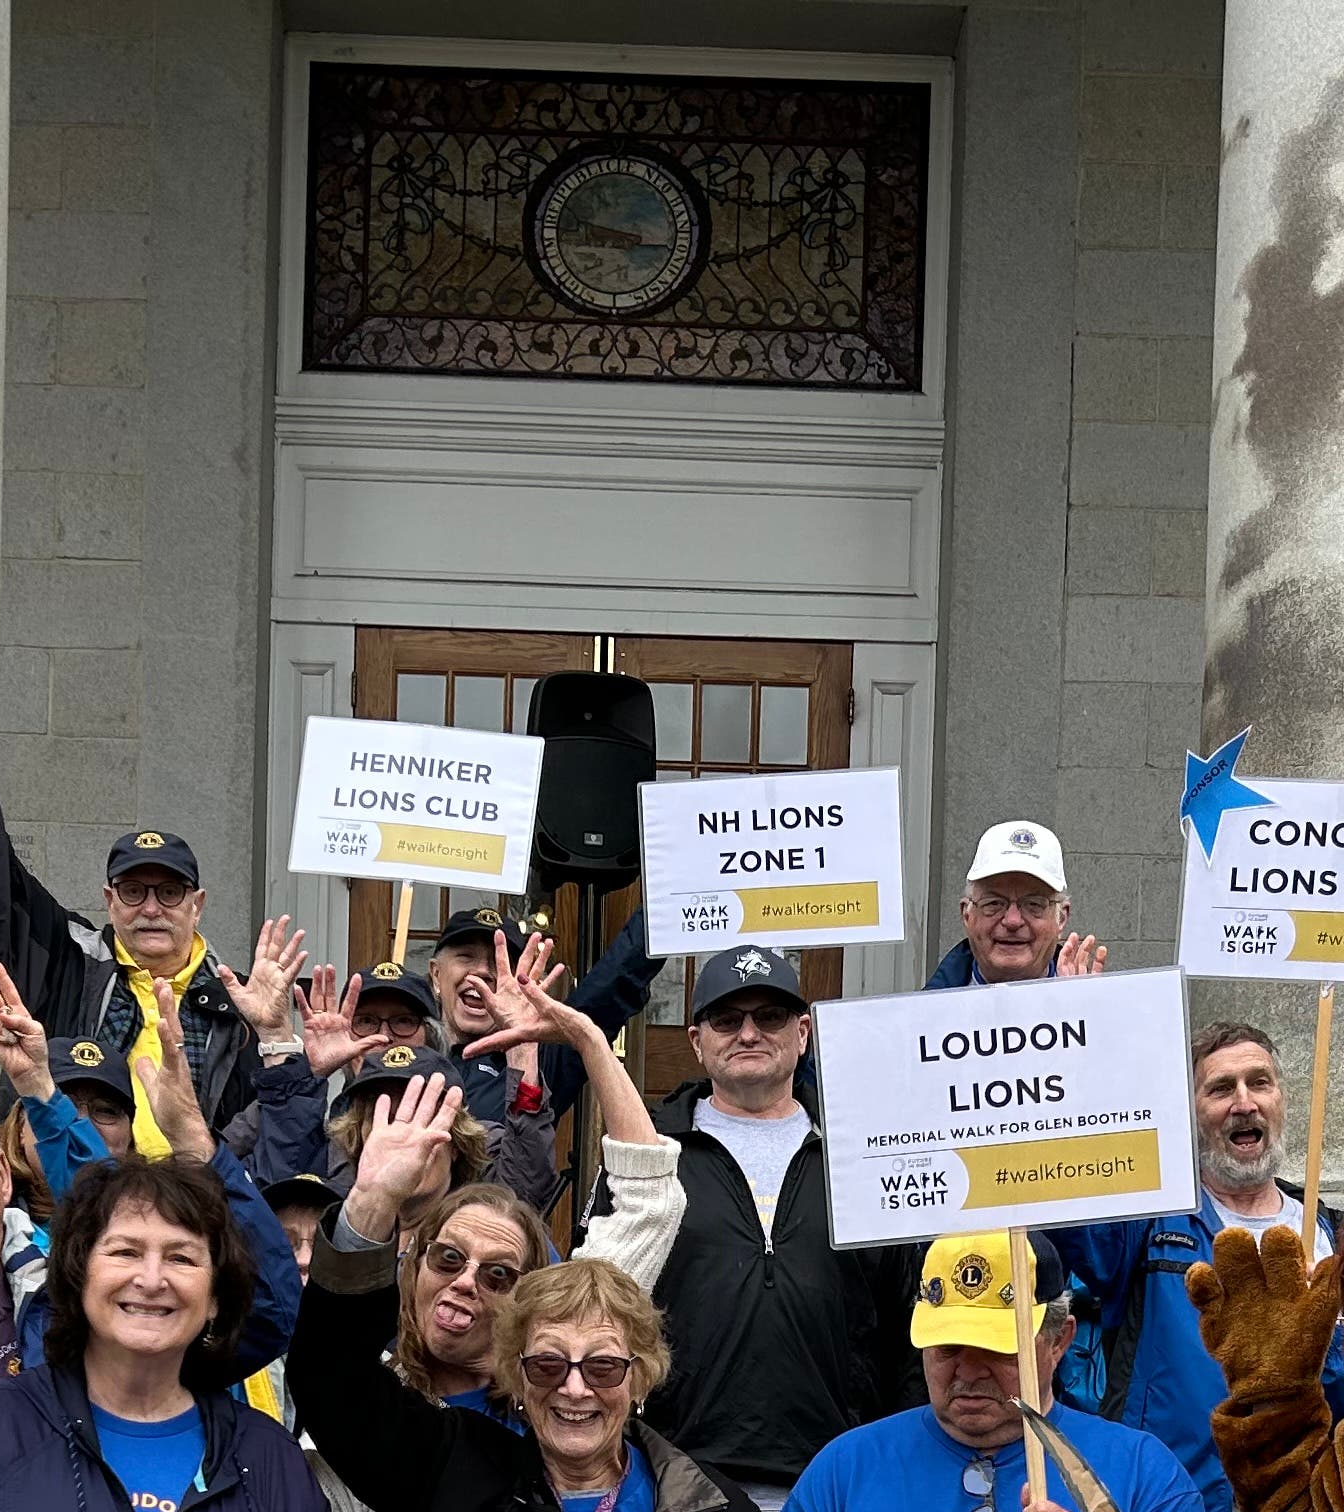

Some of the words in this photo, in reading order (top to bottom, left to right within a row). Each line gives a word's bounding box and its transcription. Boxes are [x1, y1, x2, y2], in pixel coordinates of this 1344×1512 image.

[350, 751, 492, 784] HENNIKER
[333, 787, 416, 812] LIONS
[425, 796, 498, 821] CLUB
[698, 810, 740, 835] NH
[752, 804, 844, 831] LIONS
[397, 839, 488, 861] #walkforsight
[719, 848, 805, 875] ZONE
[814, 846, 825, 868] 1
[1229, 867, 1337, 896] LIONS
[762, 899, 861, 917] #walkforsight
[919, 1019, 1087, 1063] LOUDON
[949, 1074, 1065, 1113] LIONS
[867, 1128, 945, 1149] MEMORIAL
[949, 1124, 995, 1142] WALK
[999, 1121, 1030, 1135] FOR
[1034, 1116, 1073, 1132] GLEN
[1077, 1111, 1129, 1127] BOOTH
[1133, 1108, 1152, 1121] SR
[995, 1156, 1135, 1185] #walkforsight
[965, 1267, 978, 1285] L
